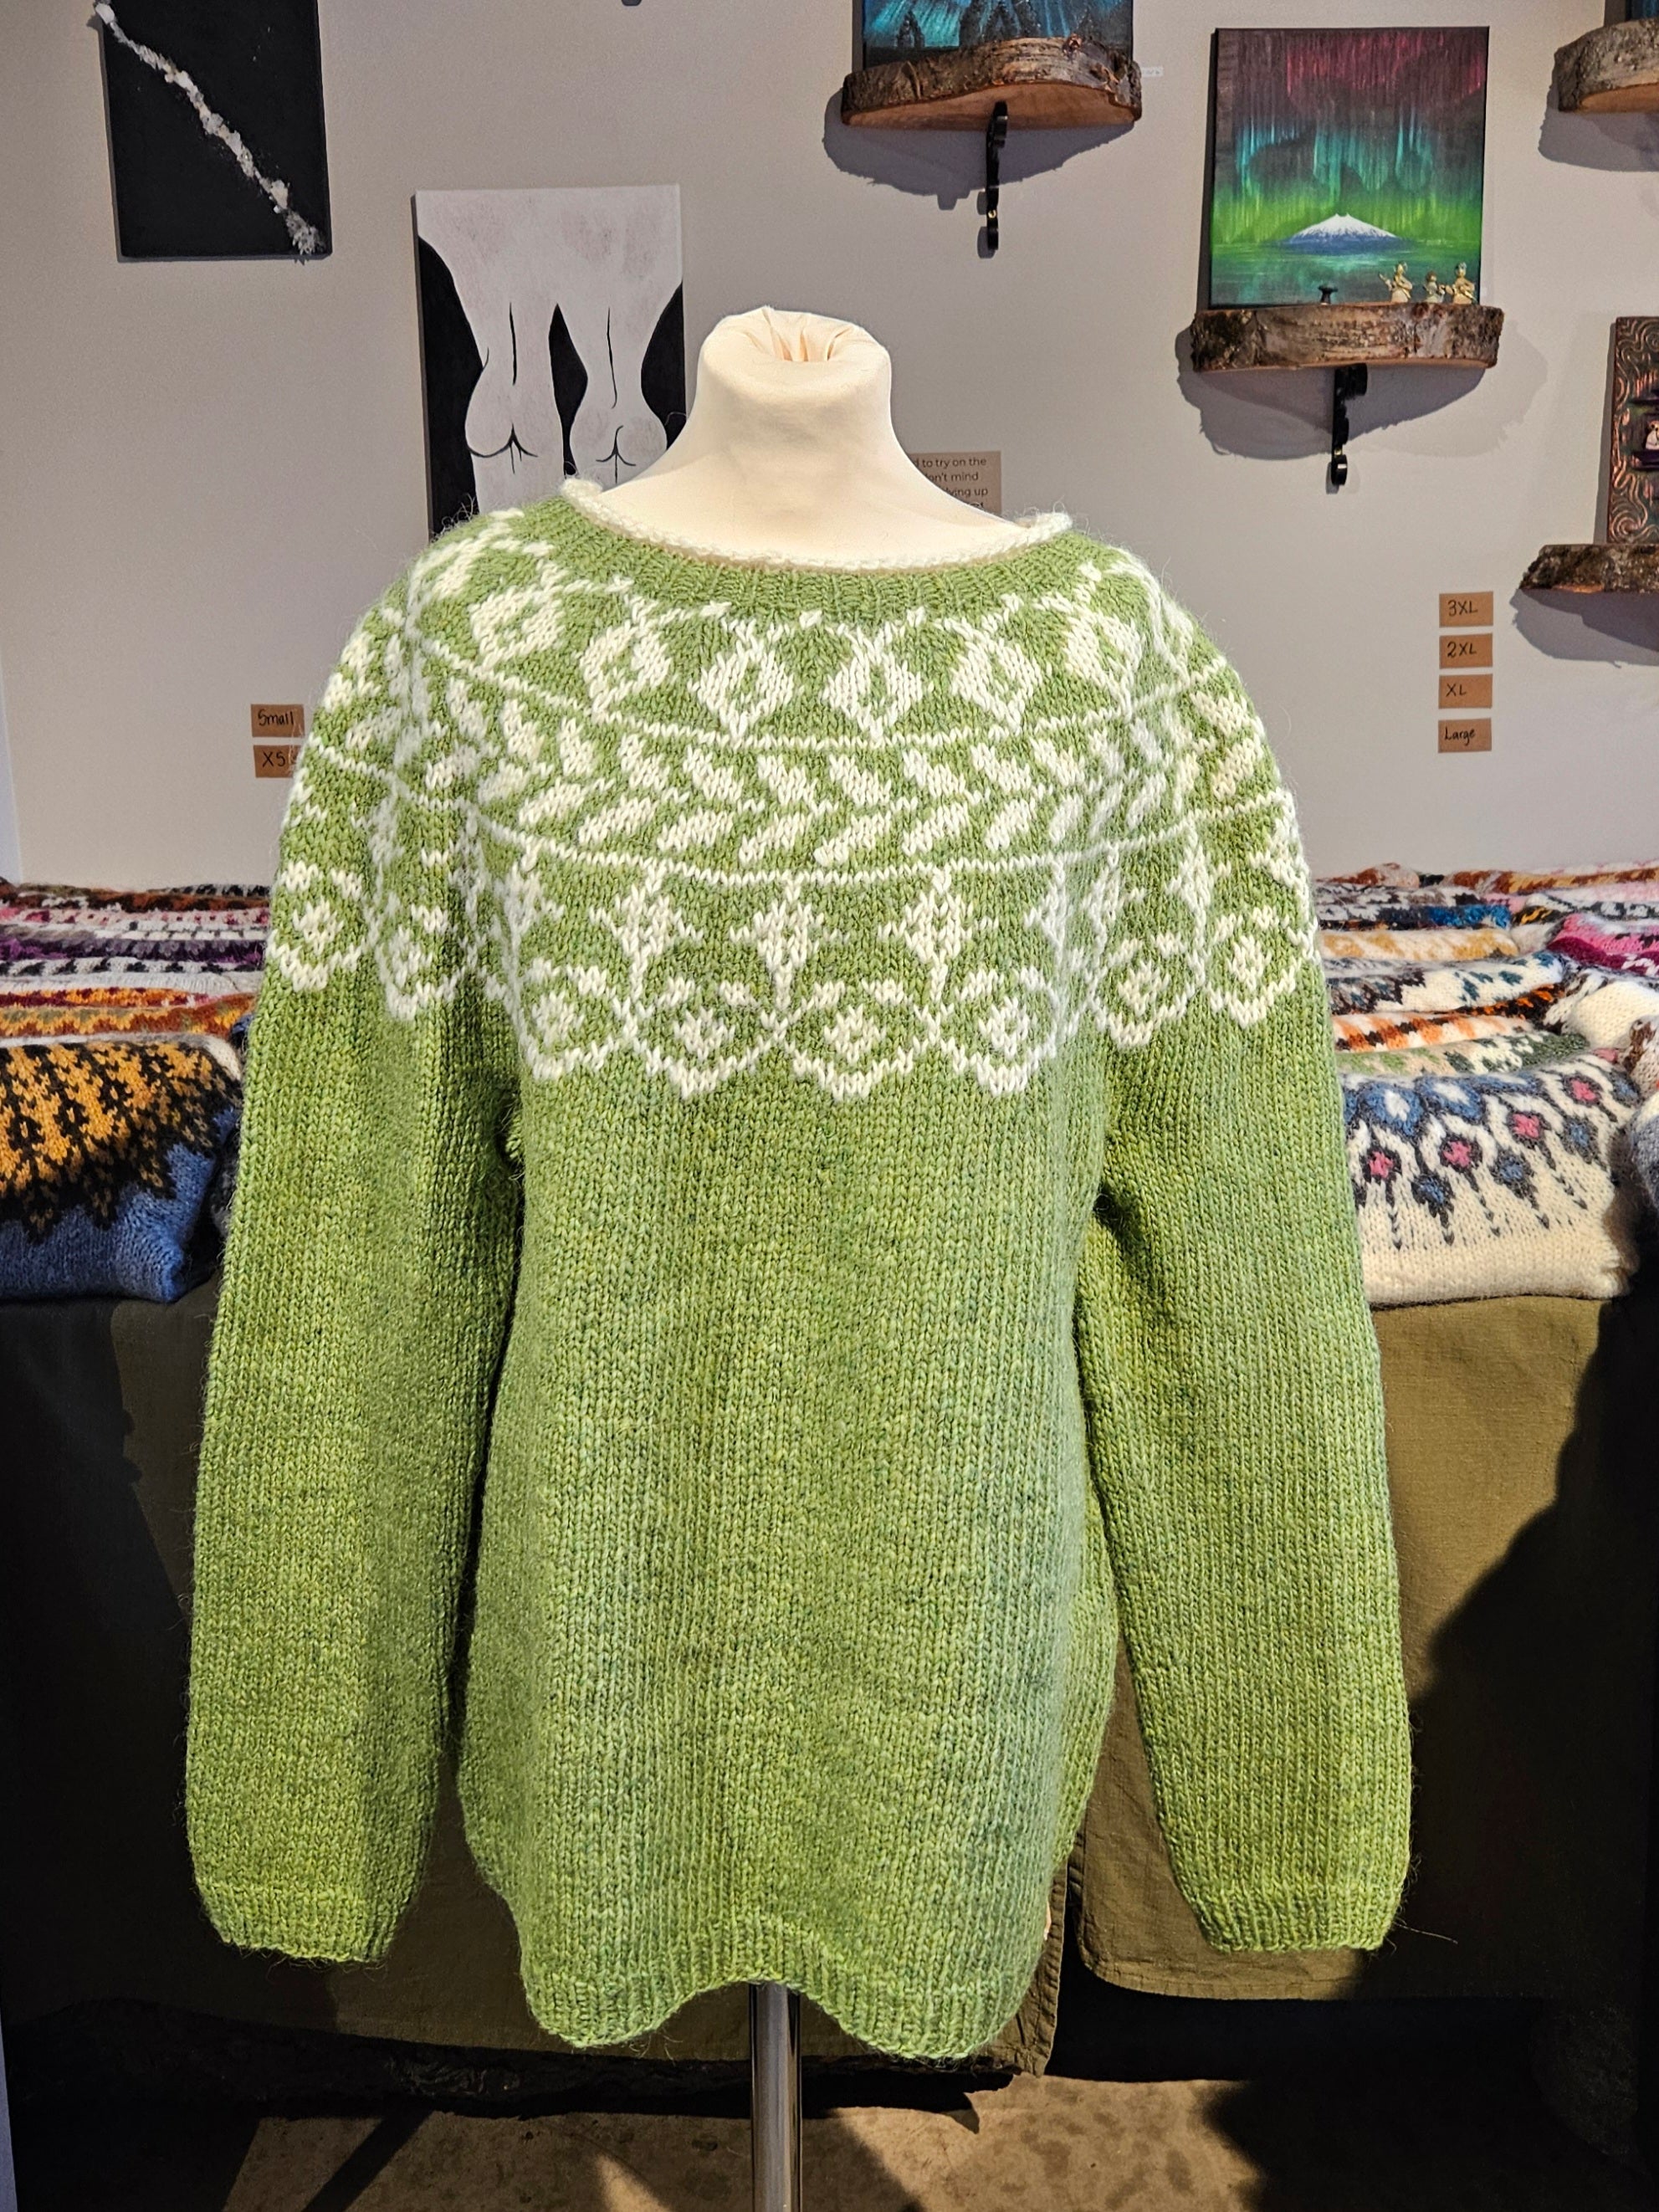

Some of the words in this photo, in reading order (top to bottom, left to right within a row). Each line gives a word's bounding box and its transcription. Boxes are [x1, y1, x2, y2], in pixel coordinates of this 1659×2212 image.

[922, 459, 933, 469] to
[935, 459, 950, 469] try
[952, 458, 966, 467] on
[969, 457, 987, 467] the
[924, 472, 948, 482] on't
[950, 471, 979, 482] mind
[974, 488, 989, 498] up
[1447, 599, 1478, 617] 3XL
[1447, 641, 1477, 658] 2XL
[1446, 683, 1467, 697] XL
[258, 708, 294, 726] Small
[1444, 725, 1477, 746] Large
